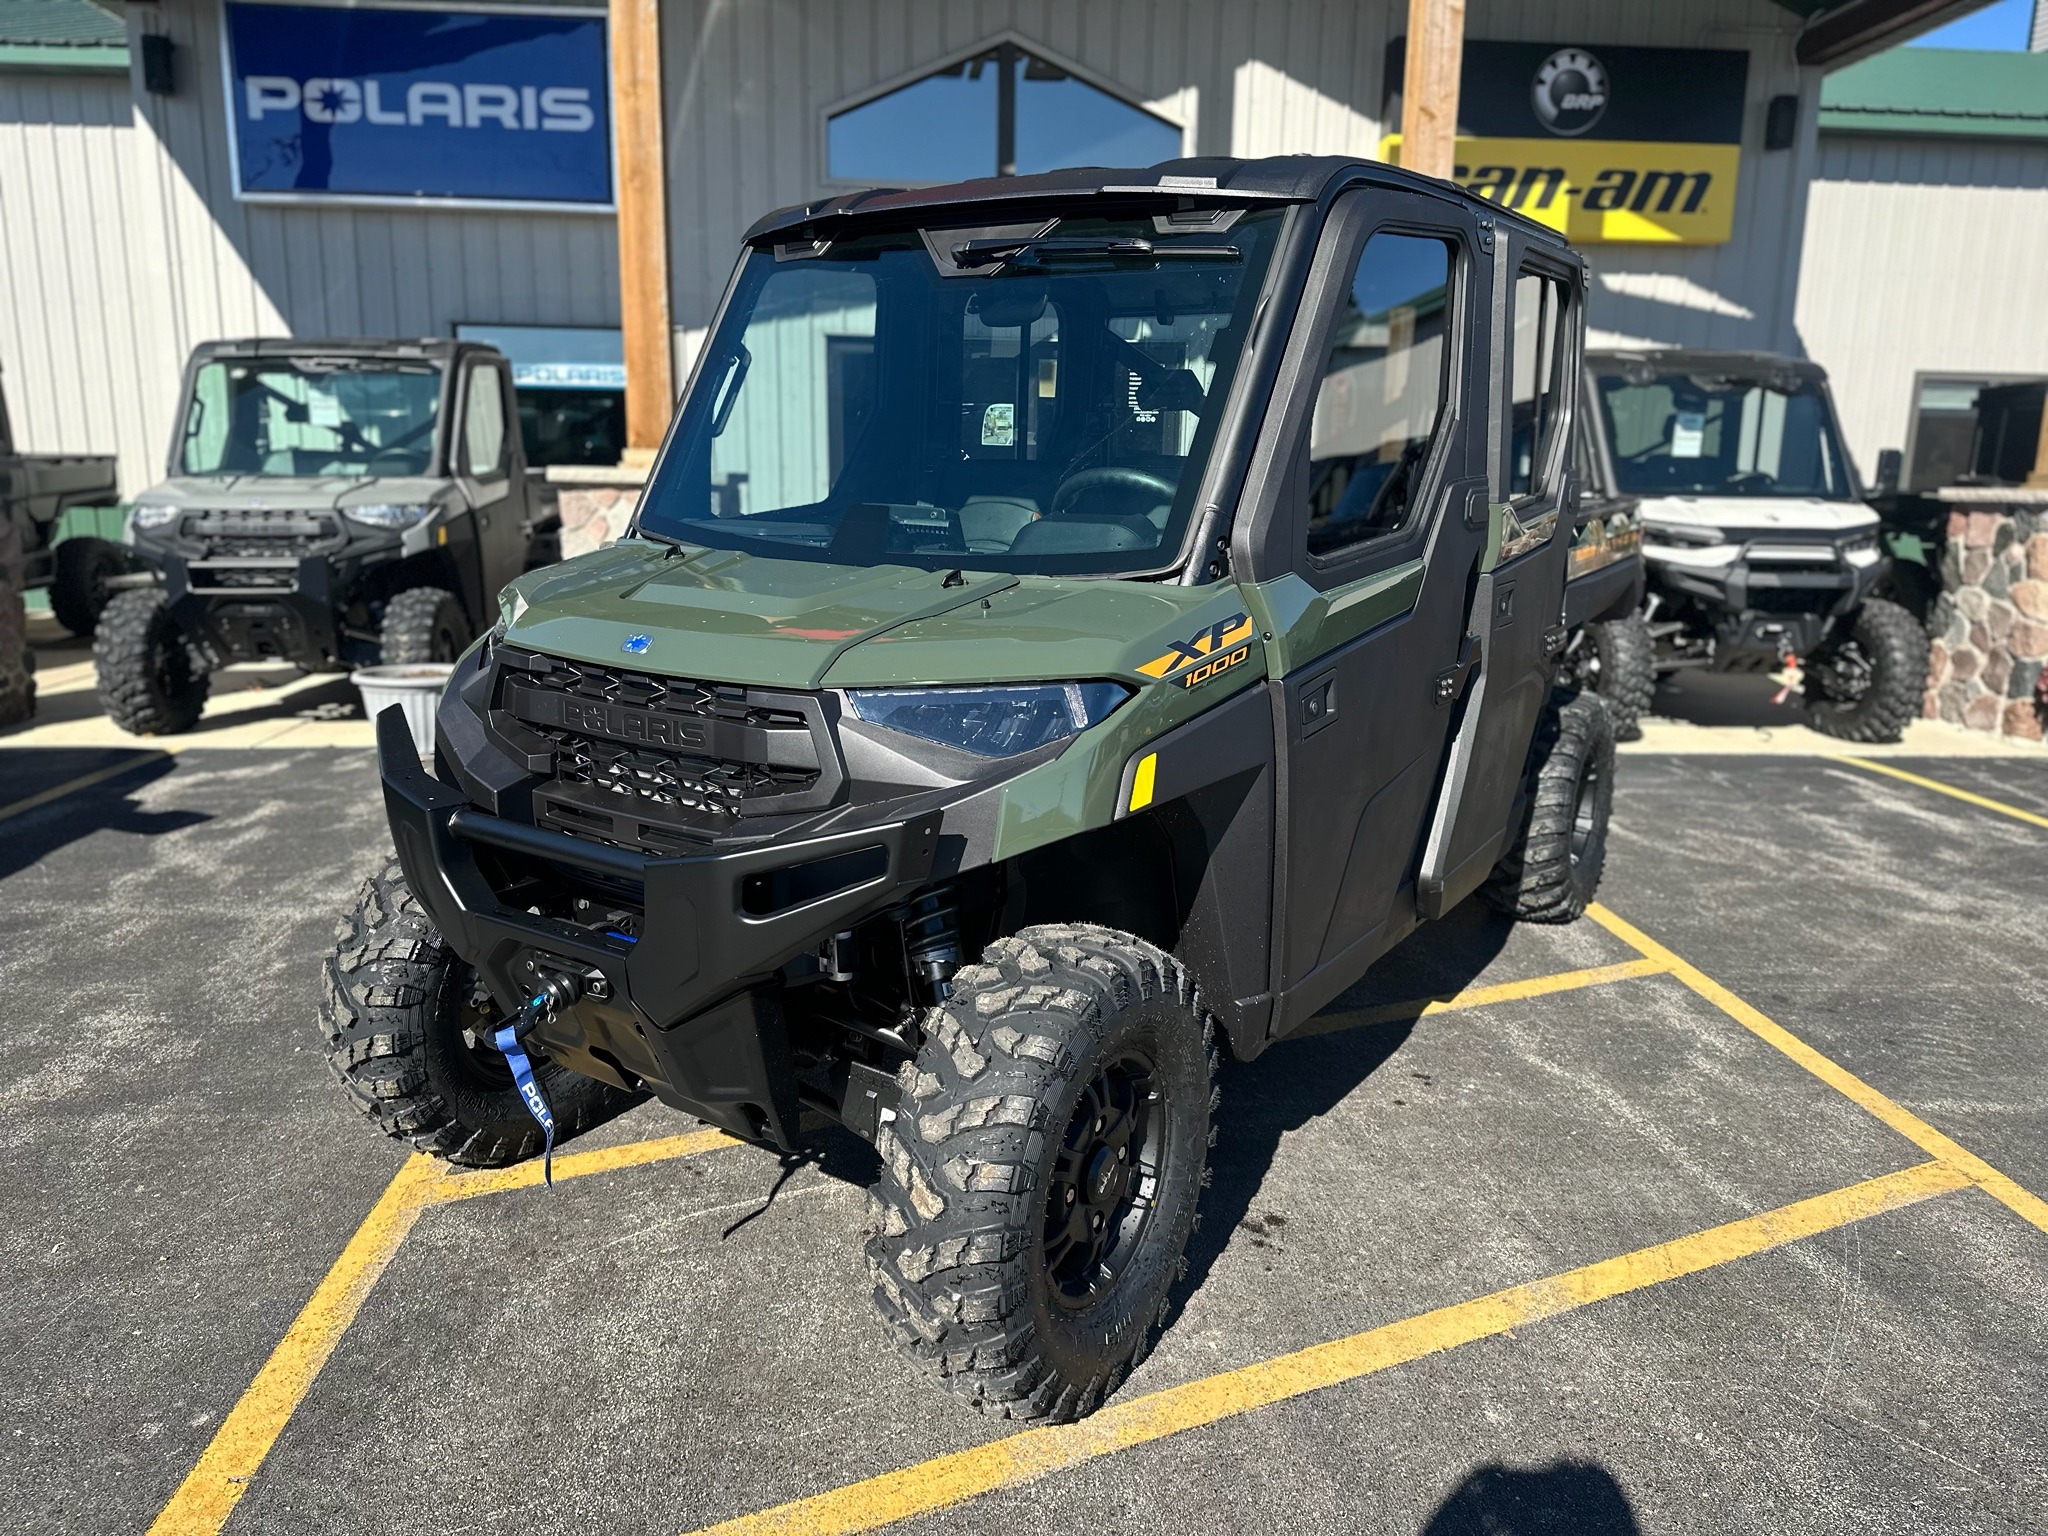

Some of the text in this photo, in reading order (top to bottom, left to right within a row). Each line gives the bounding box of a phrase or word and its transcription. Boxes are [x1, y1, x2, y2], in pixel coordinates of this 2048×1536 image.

[245, 75, 595, 132] POLARIS
[1561, 93, 1605, 110] BRP
[1453, 165, 1713, 214] an-am
[1161, 611, 1248, 676] XP
[1185, 646, 1248, 688] 1000
[562, 700, 707, 749] POLARIS
